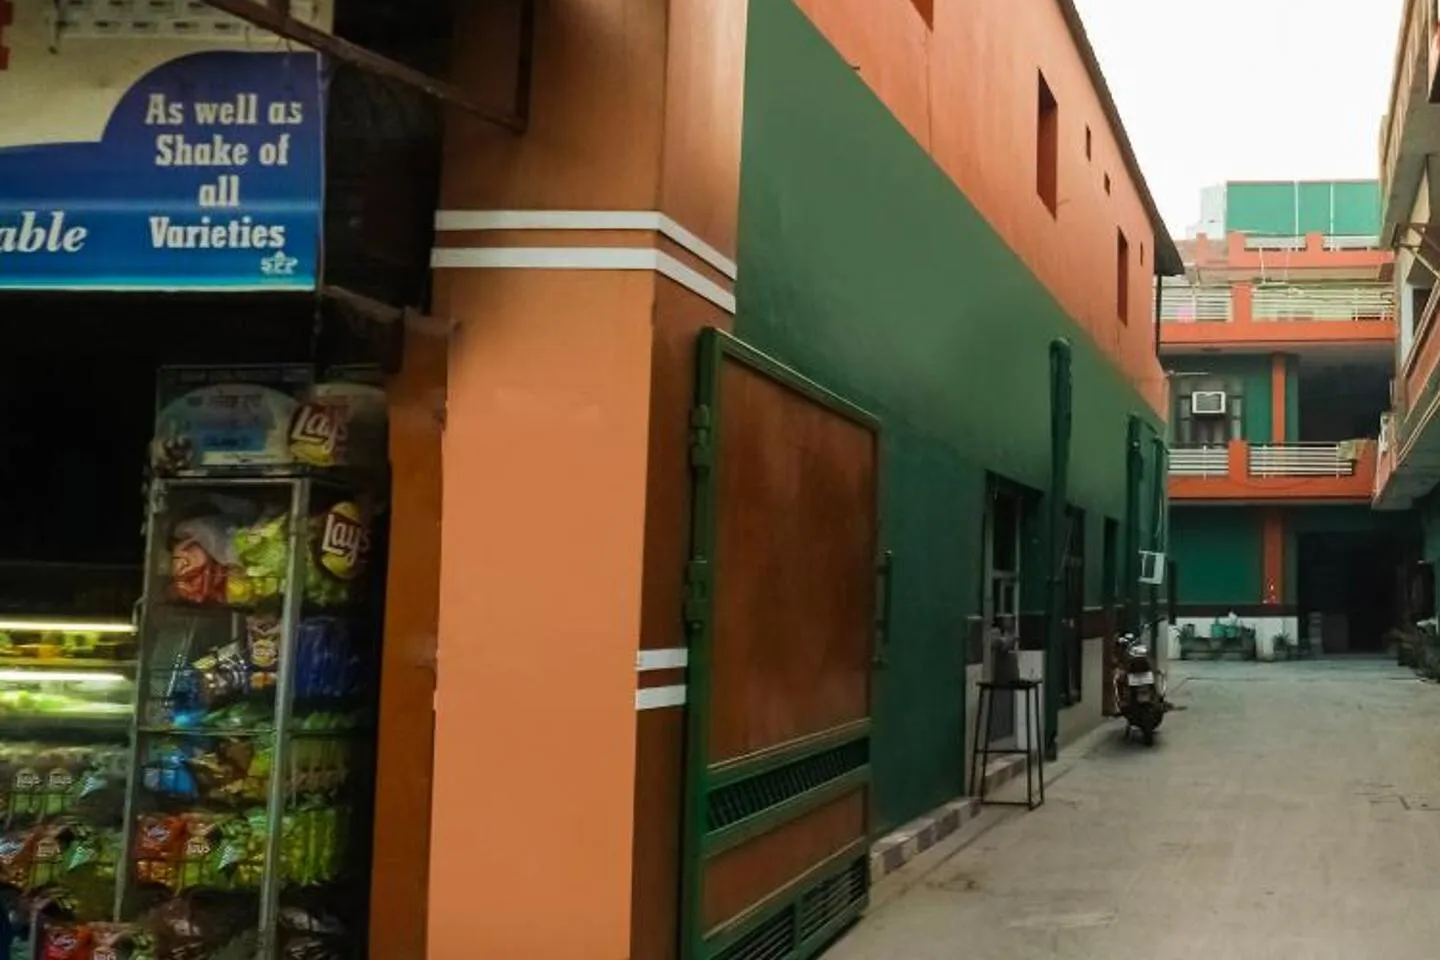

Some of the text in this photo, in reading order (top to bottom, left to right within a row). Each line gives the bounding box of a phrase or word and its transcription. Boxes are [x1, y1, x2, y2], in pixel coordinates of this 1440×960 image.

[145, 93, 303, 125] As well as
[155, 134, 291, 166] Shake of
[199, 175, 240, 208] all
[149, 216, 286, 249] Varieties
